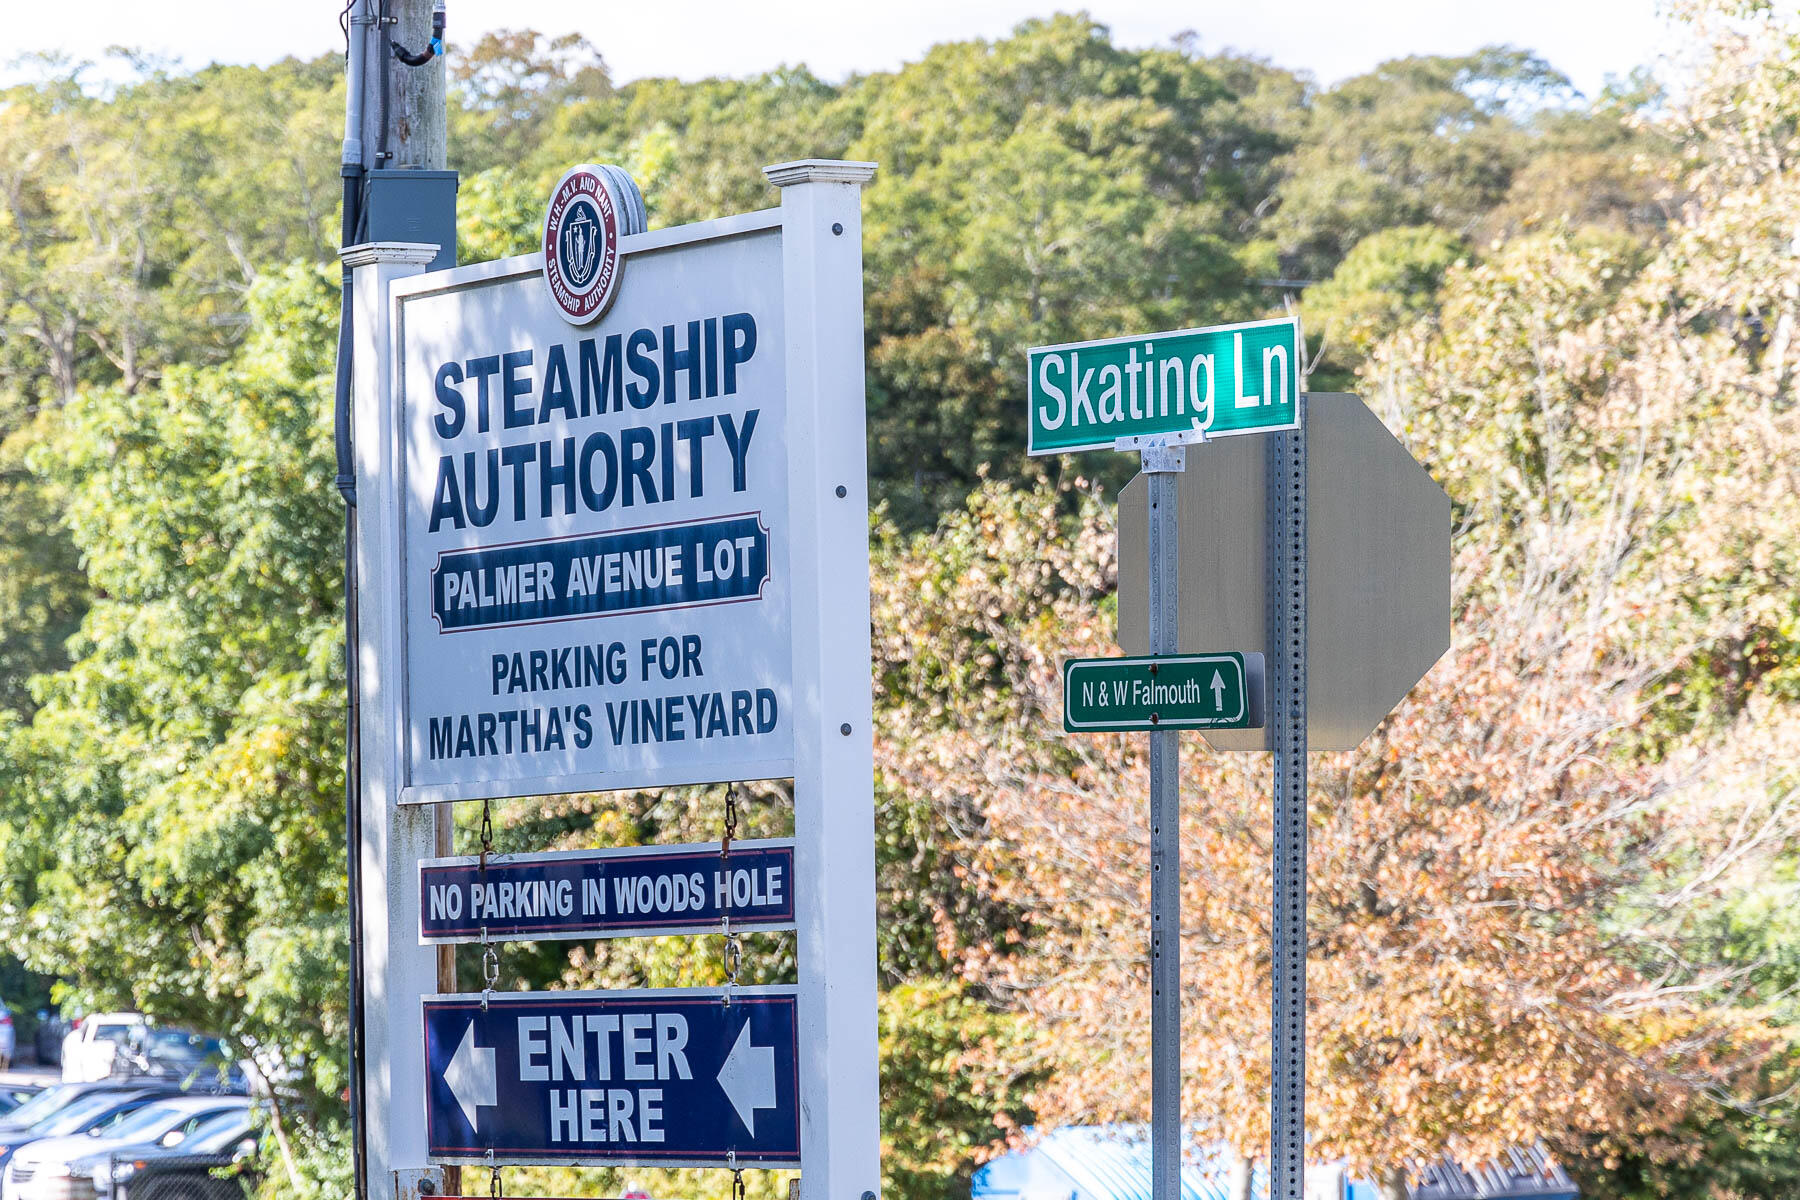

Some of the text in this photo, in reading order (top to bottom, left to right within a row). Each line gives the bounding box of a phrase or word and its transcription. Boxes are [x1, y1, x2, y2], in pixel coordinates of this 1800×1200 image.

[580, 176, 596, 193] AND
[548, 246, 615, 312] STEAMSHIP AUTHORITY
[434, 312, 757, 439] STEAMSHIP
[1039, 332, 1289, 431] Skating Ln
[429, 409, 760, 533] AUTHORITY
[443, 536, 756, 611] PALMER AVENUE LOT
[492, 634, 703, 695] PARKING FOR
[1082, 678, 1201, 707] N & W Falmouth
[429, 687, 778, 760] MARTHA'S VINEYARD
[429, 866, 783, 920] NO PARKING IN WOODS HOLE
[518, 1013, 694, 1082] ENTER
[550, 1088, 666, 1143] HERE
